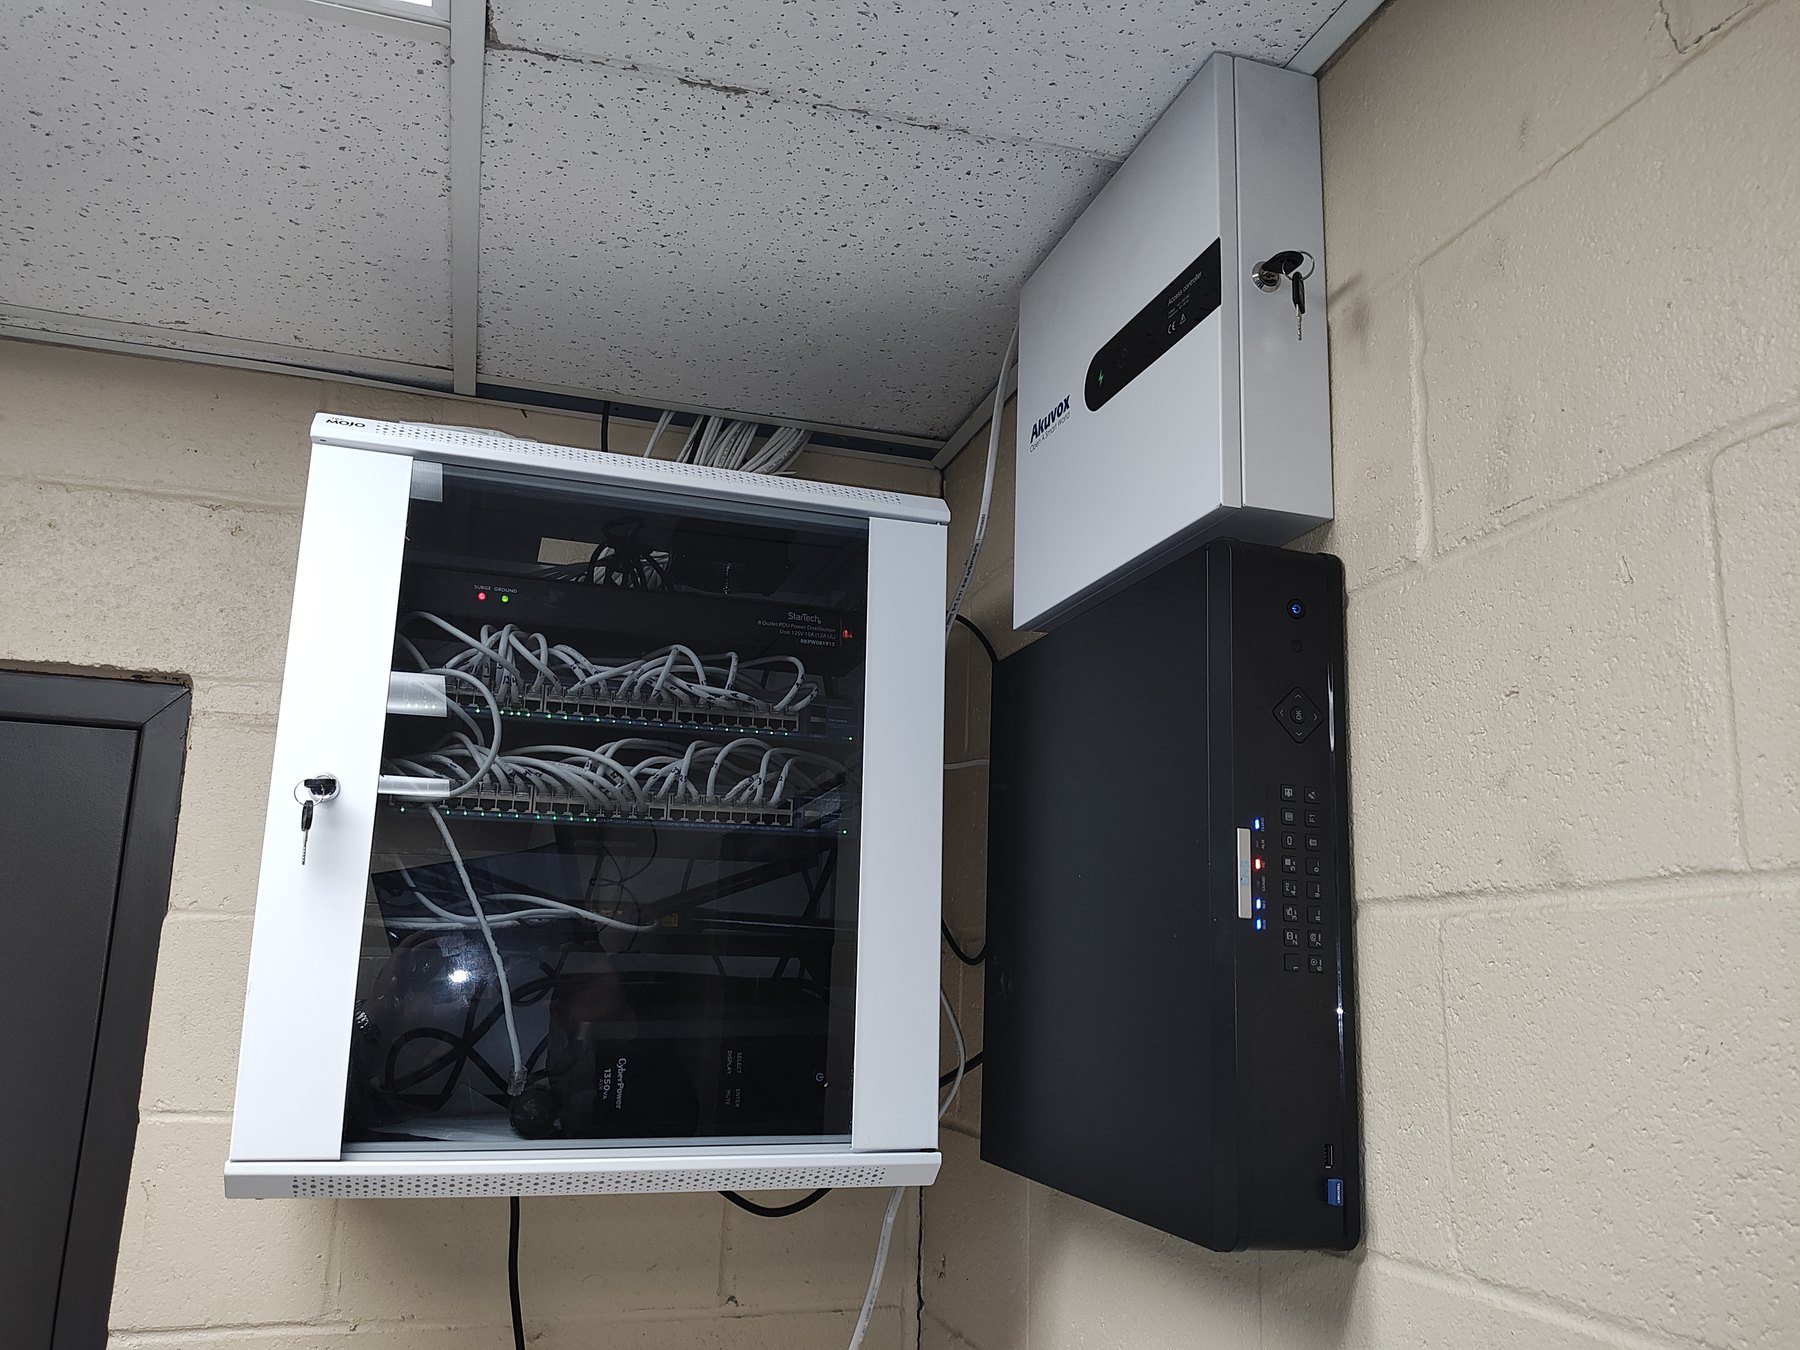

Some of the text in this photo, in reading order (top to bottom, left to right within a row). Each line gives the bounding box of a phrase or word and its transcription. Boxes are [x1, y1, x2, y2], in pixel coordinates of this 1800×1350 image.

[326, 418, 366, 428] MOJO
[1030, 394, 1070, 444] Akuvox
[493, 586, 518, 594] GROUND
[806, 624, 836, 633] Distribution
[1294, 708, 1303, 721] OK
[1309, 813, 1316, 823] F1
[615, 1057, 627, 1110] CyberPower
[724, 1089, 732, 1106] MUTE
